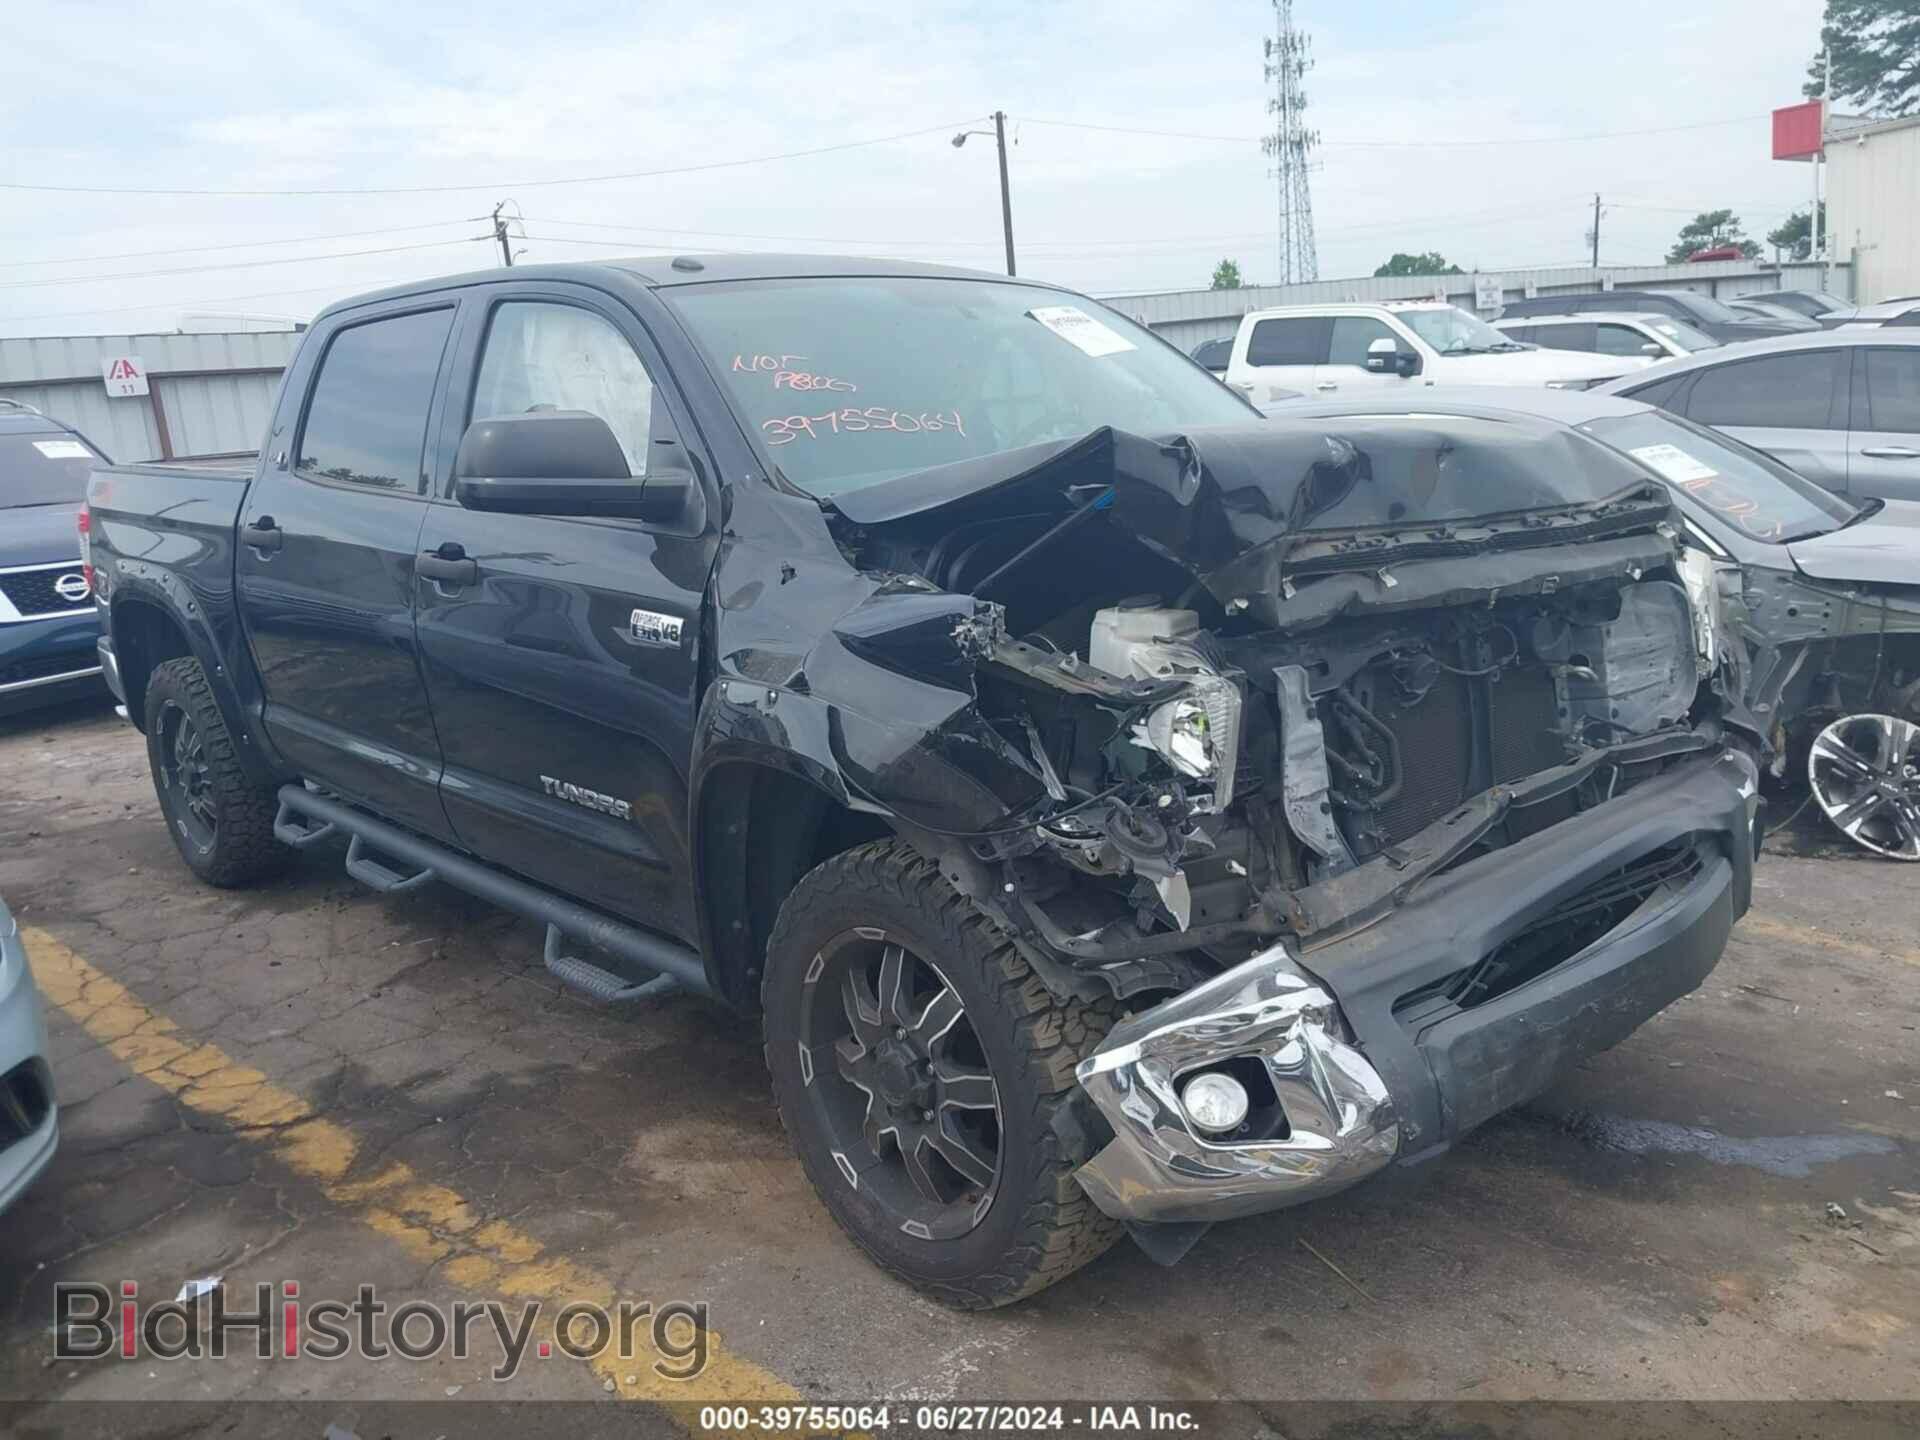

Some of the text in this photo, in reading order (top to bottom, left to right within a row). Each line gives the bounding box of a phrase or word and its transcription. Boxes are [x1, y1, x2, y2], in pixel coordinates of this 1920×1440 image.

[121, 384, 135, 394] 11
[762, 407, 966, 445] 39755064
[540, 775, 632, 820] TUNDRA
